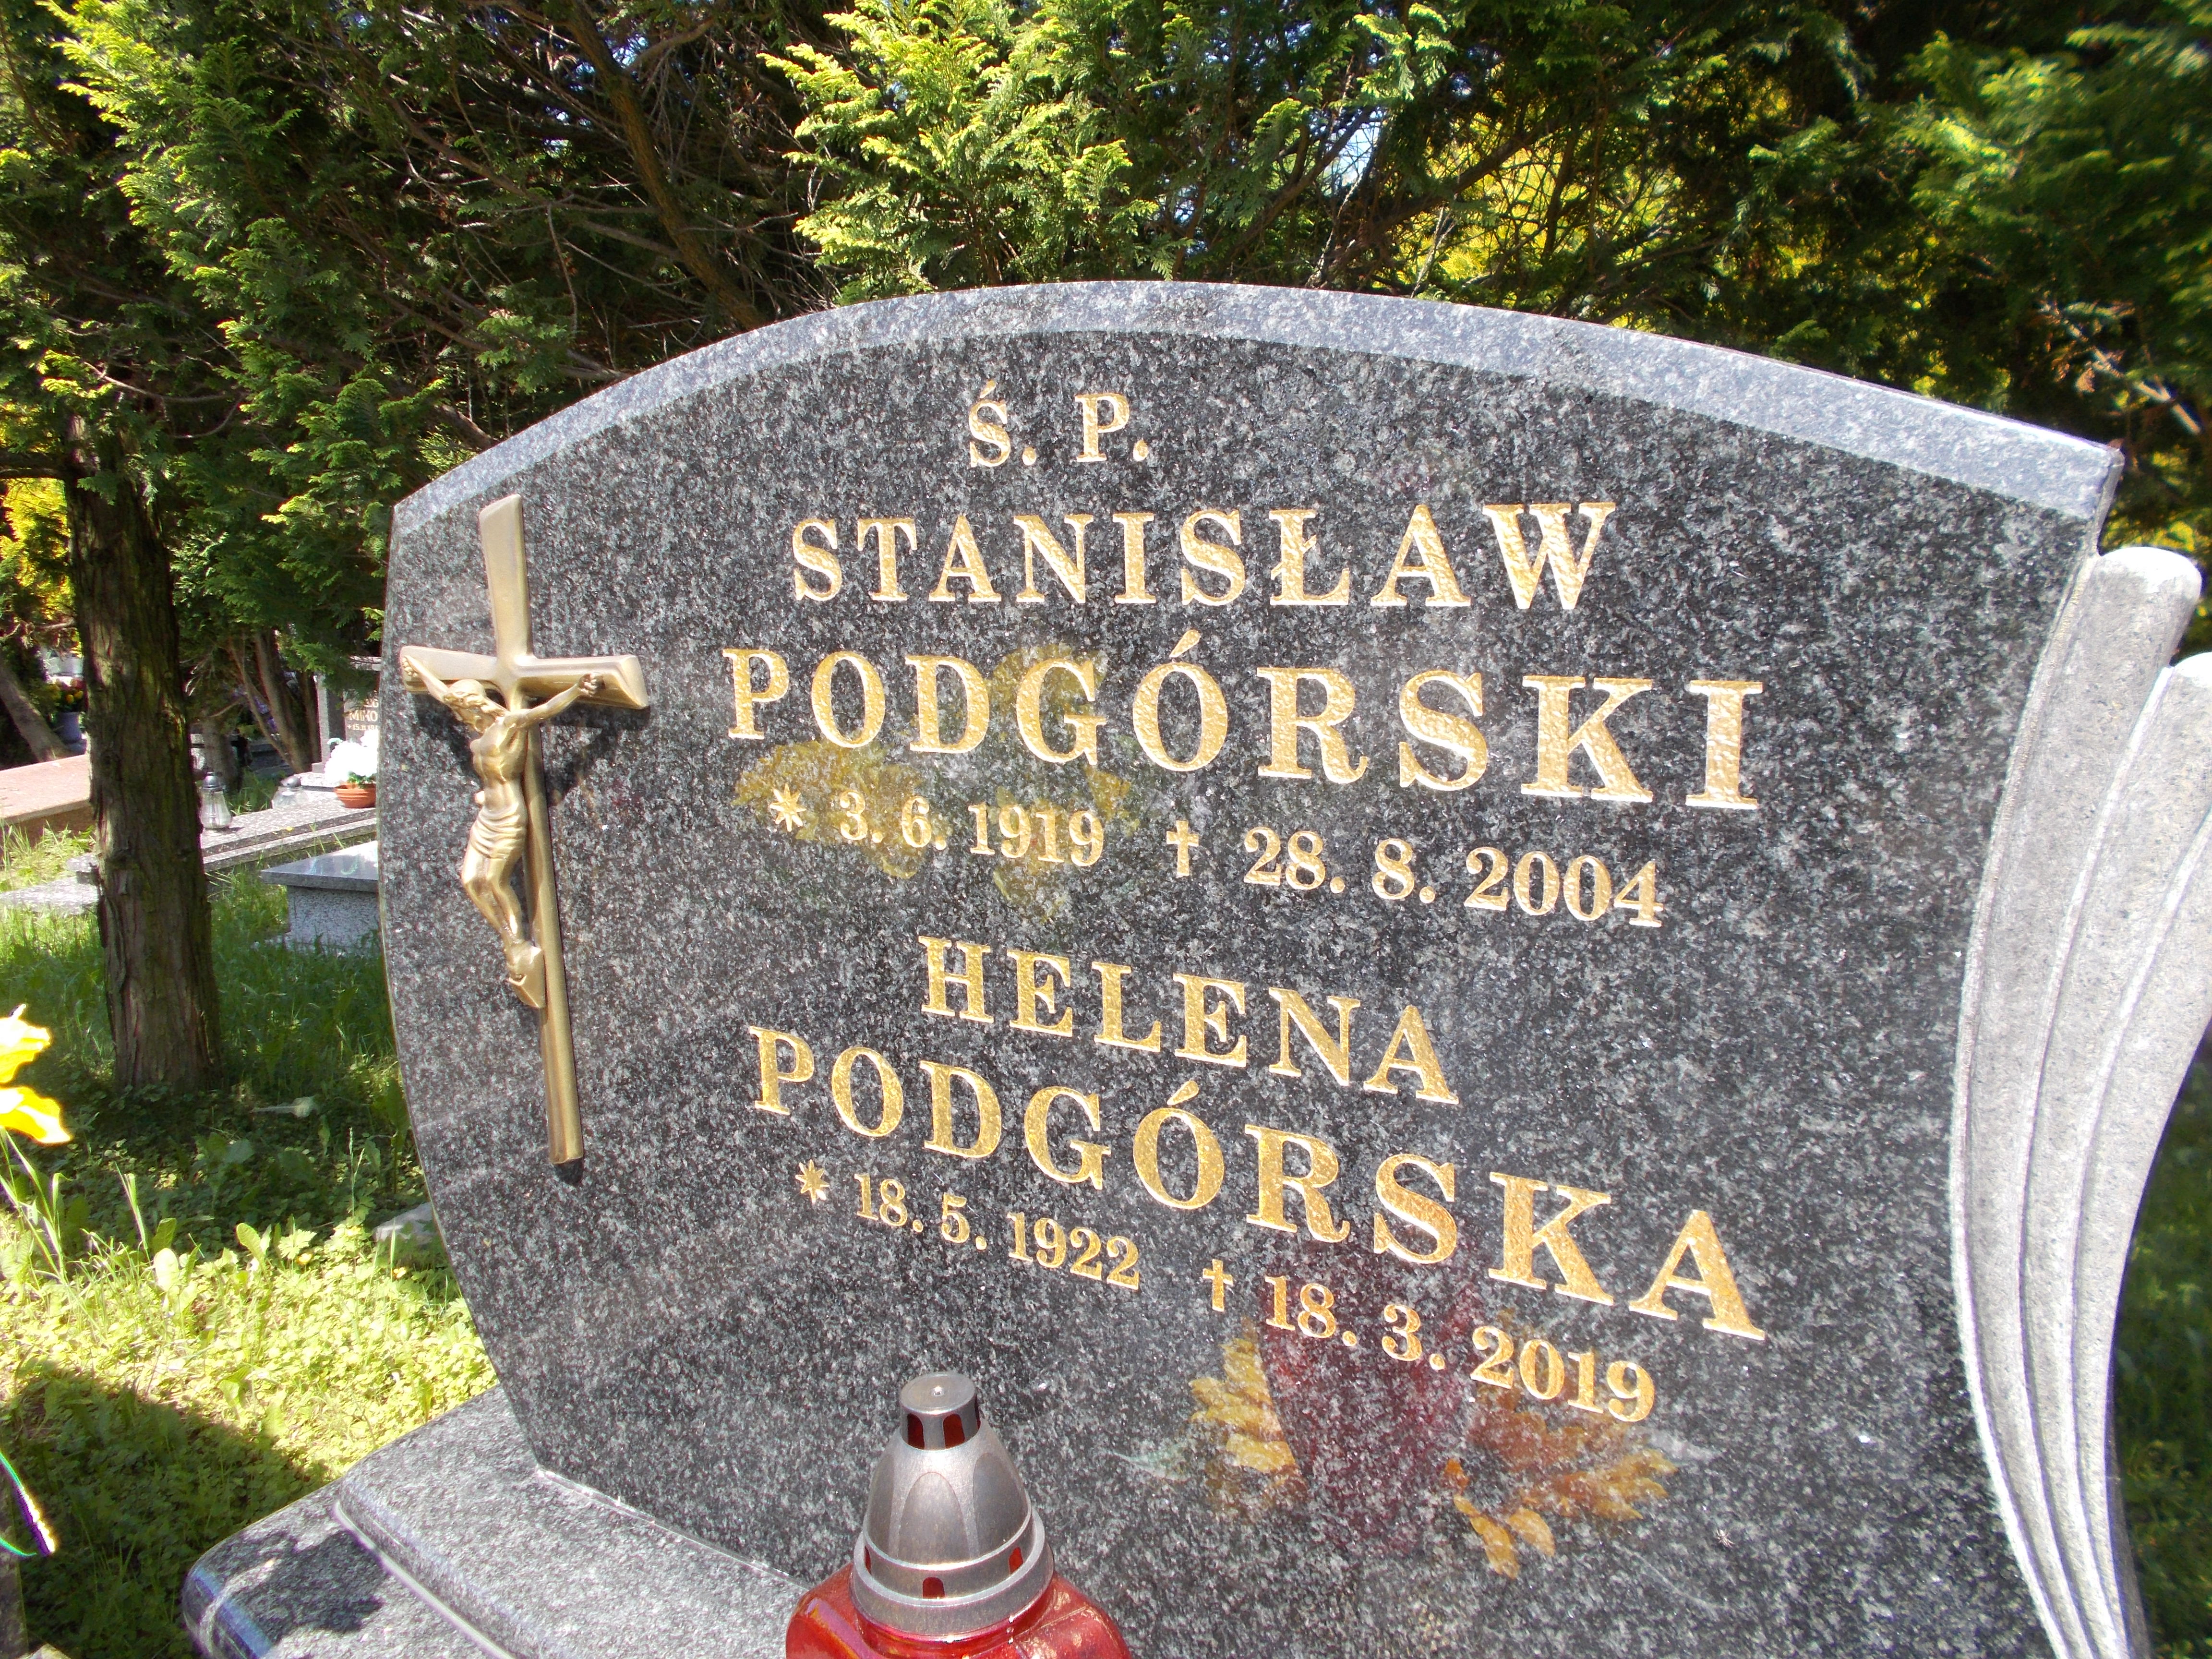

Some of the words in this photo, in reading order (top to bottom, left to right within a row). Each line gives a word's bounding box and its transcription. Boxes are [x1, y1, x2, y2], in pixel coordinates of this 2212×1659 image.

[968, 381, 1037, 468] Ś.
[1075, 393, 1149, 462] P.
[793, 502, 1616, 610] STANISŁAW
[722, 629, 1763, 809] PODGÓRSKI
[969, 802, 1104, 866] 1919
[1465, 847, 1664, 928] 2004
[918, 936, 1459, 1104] HELENA
[749, 1026, 1766, 1340] PODGÓRSKA
[1007, 1212, 1140, 1290] 1922
[1471, 1326, 1656, 1422] 2019
